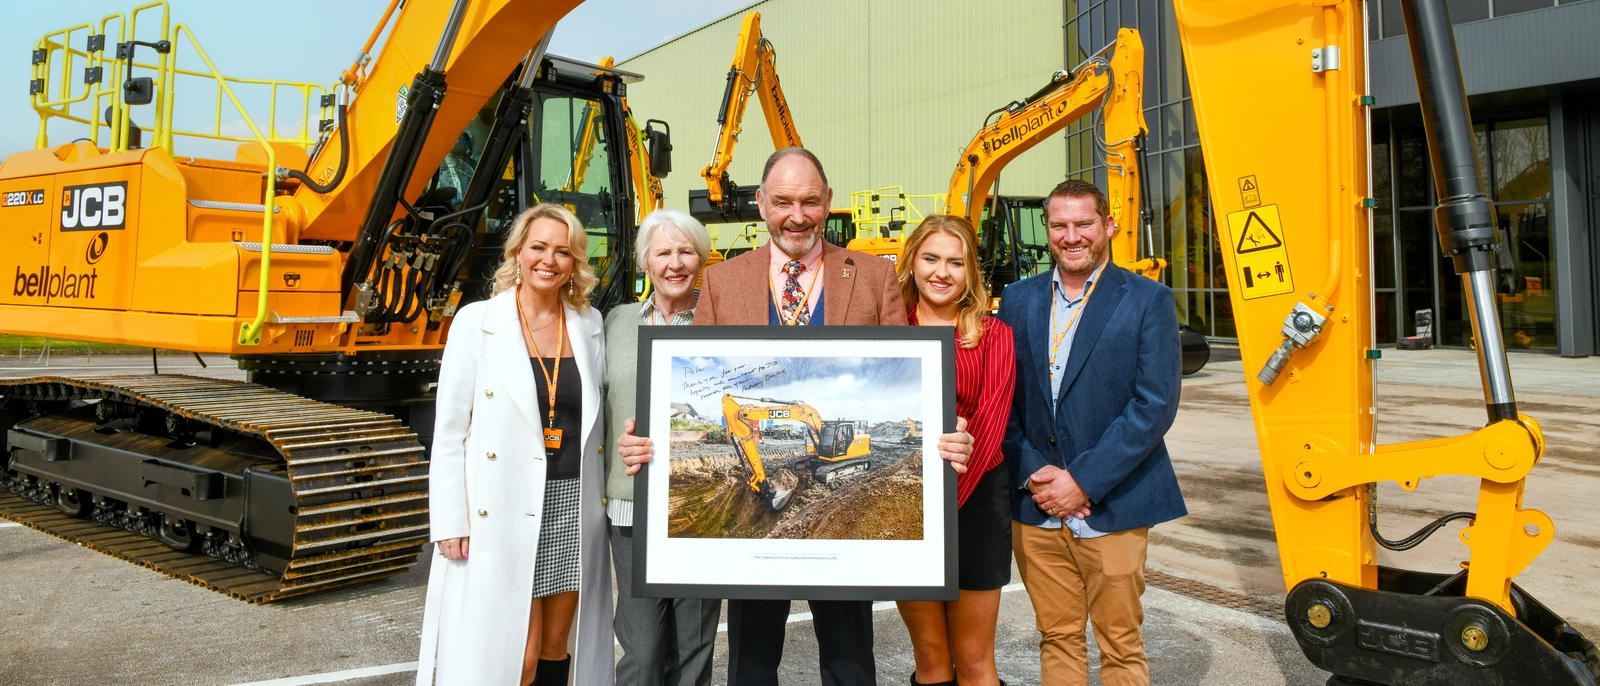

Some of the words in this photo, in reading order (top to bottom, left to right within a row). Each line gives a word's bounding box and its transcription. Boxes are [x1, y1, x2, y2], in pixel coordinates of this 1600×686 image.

[771, 84, 797, 147] bellplan
[991, 107, 1055, 152] bellplant
[61, 185, 125, 228] JCB
[13, 265, 98, 304] bellplant
[769, 409, 791, 419] JCB
